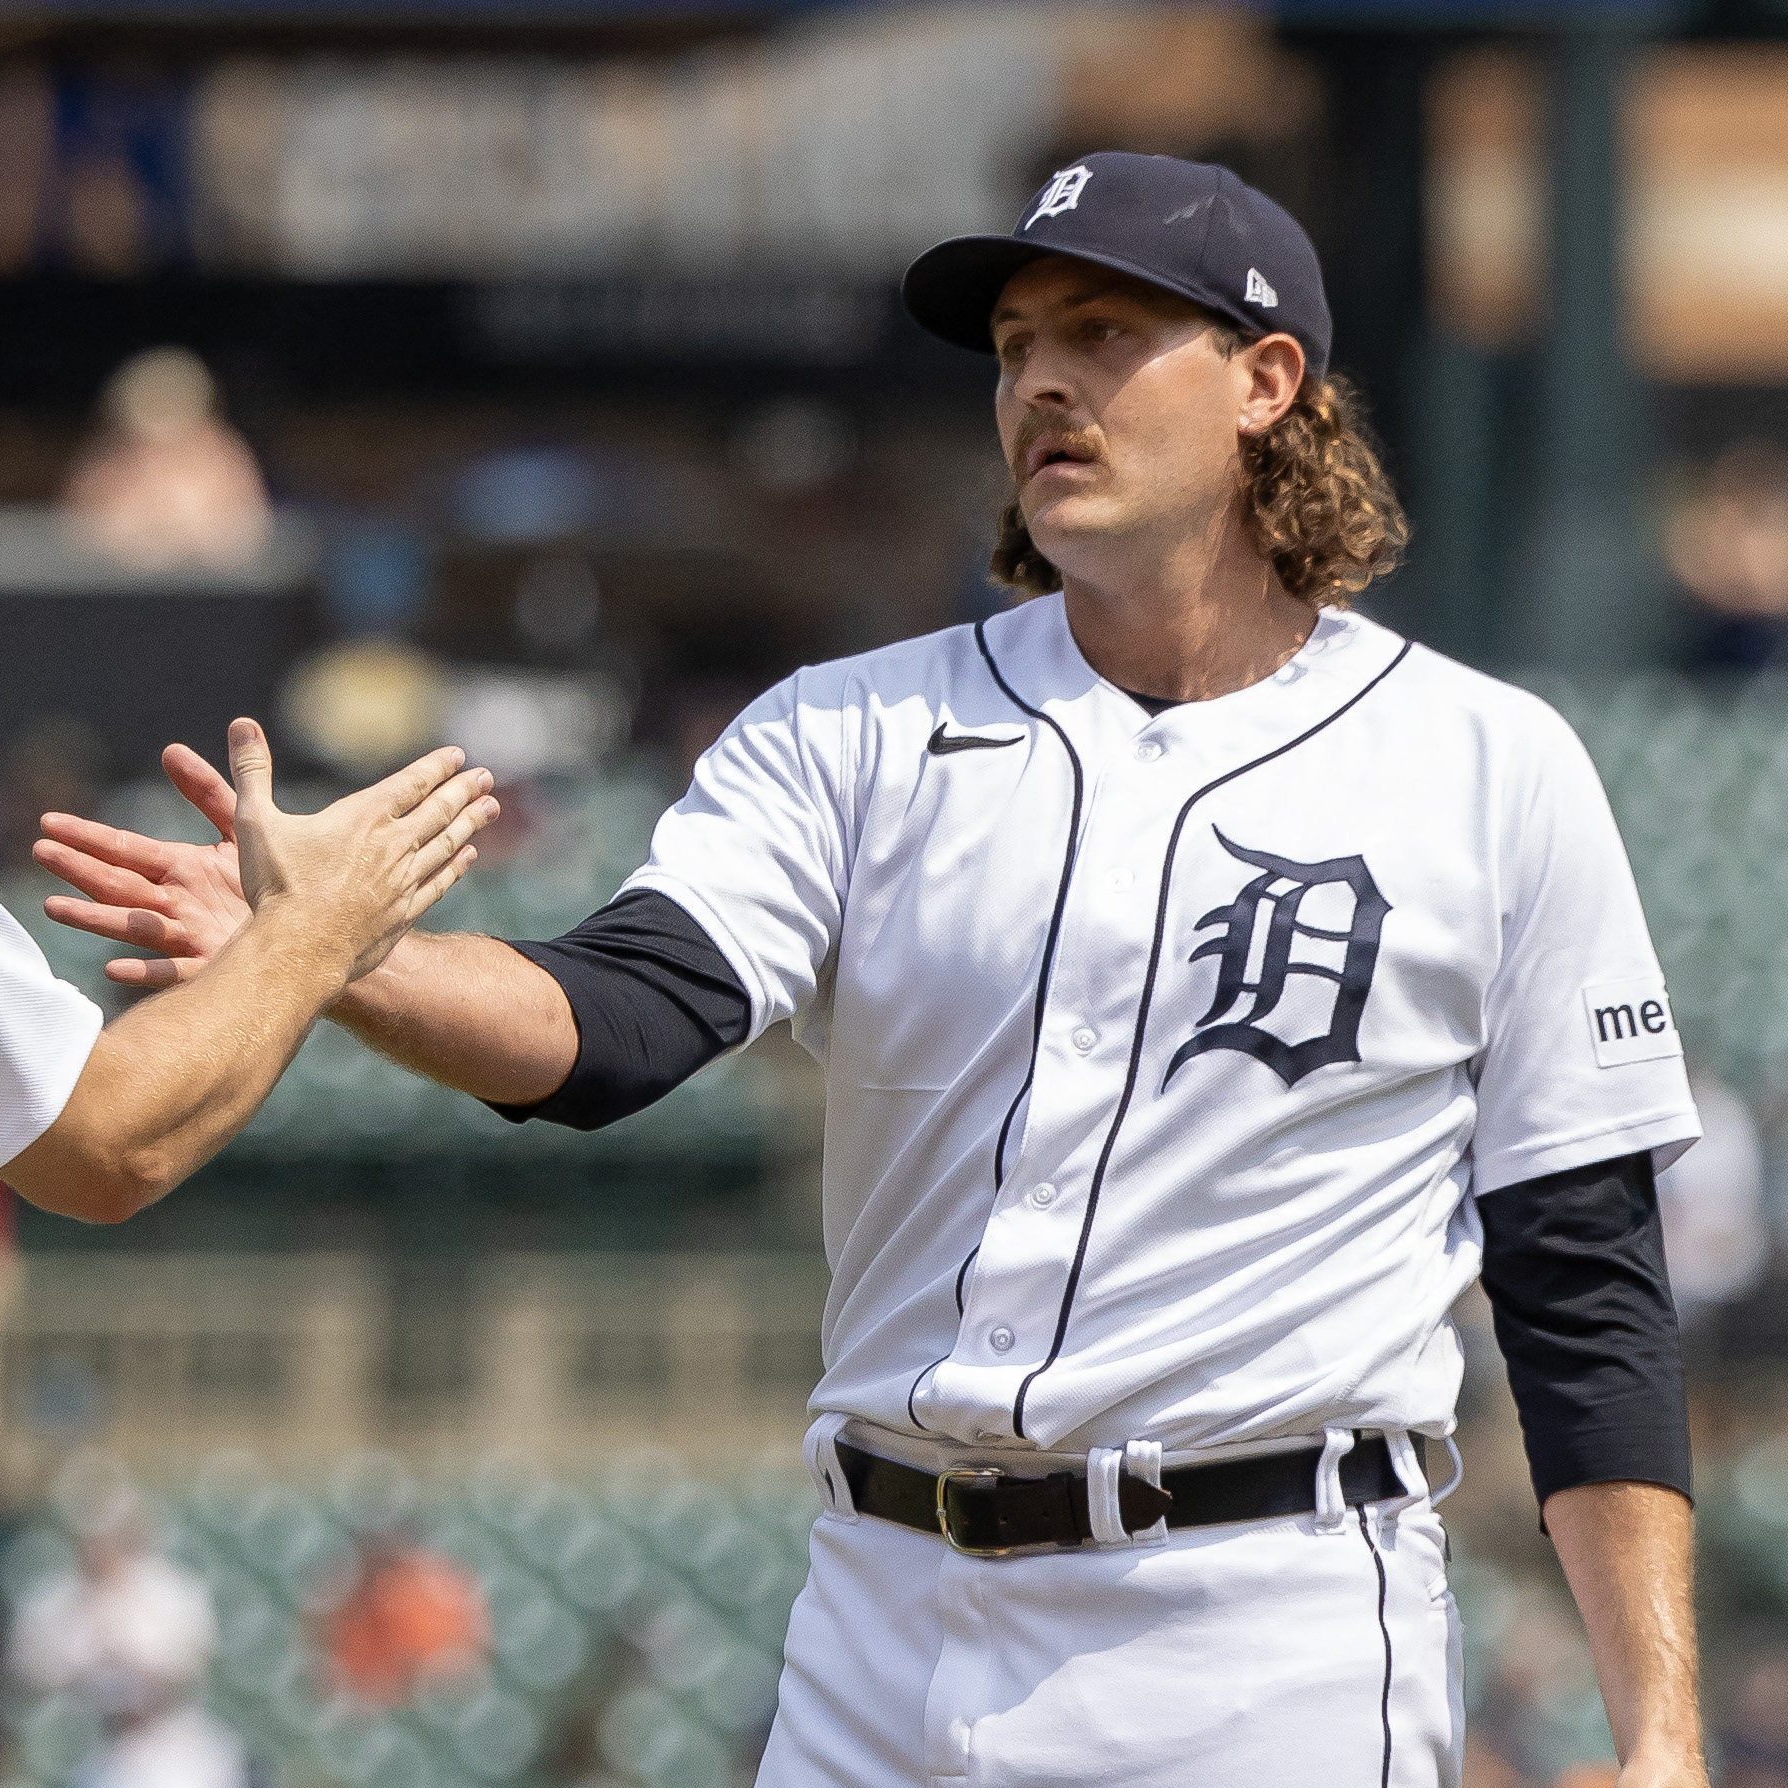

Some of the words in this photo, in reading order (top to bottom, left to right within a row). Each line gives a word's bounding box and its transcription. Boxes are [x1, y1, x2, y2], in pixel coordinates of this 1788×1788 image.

[1026, 165, 1093, 230] D
[1163, 824, 1393, 1094] D
[1595, 1000, 1666, 1041] me
